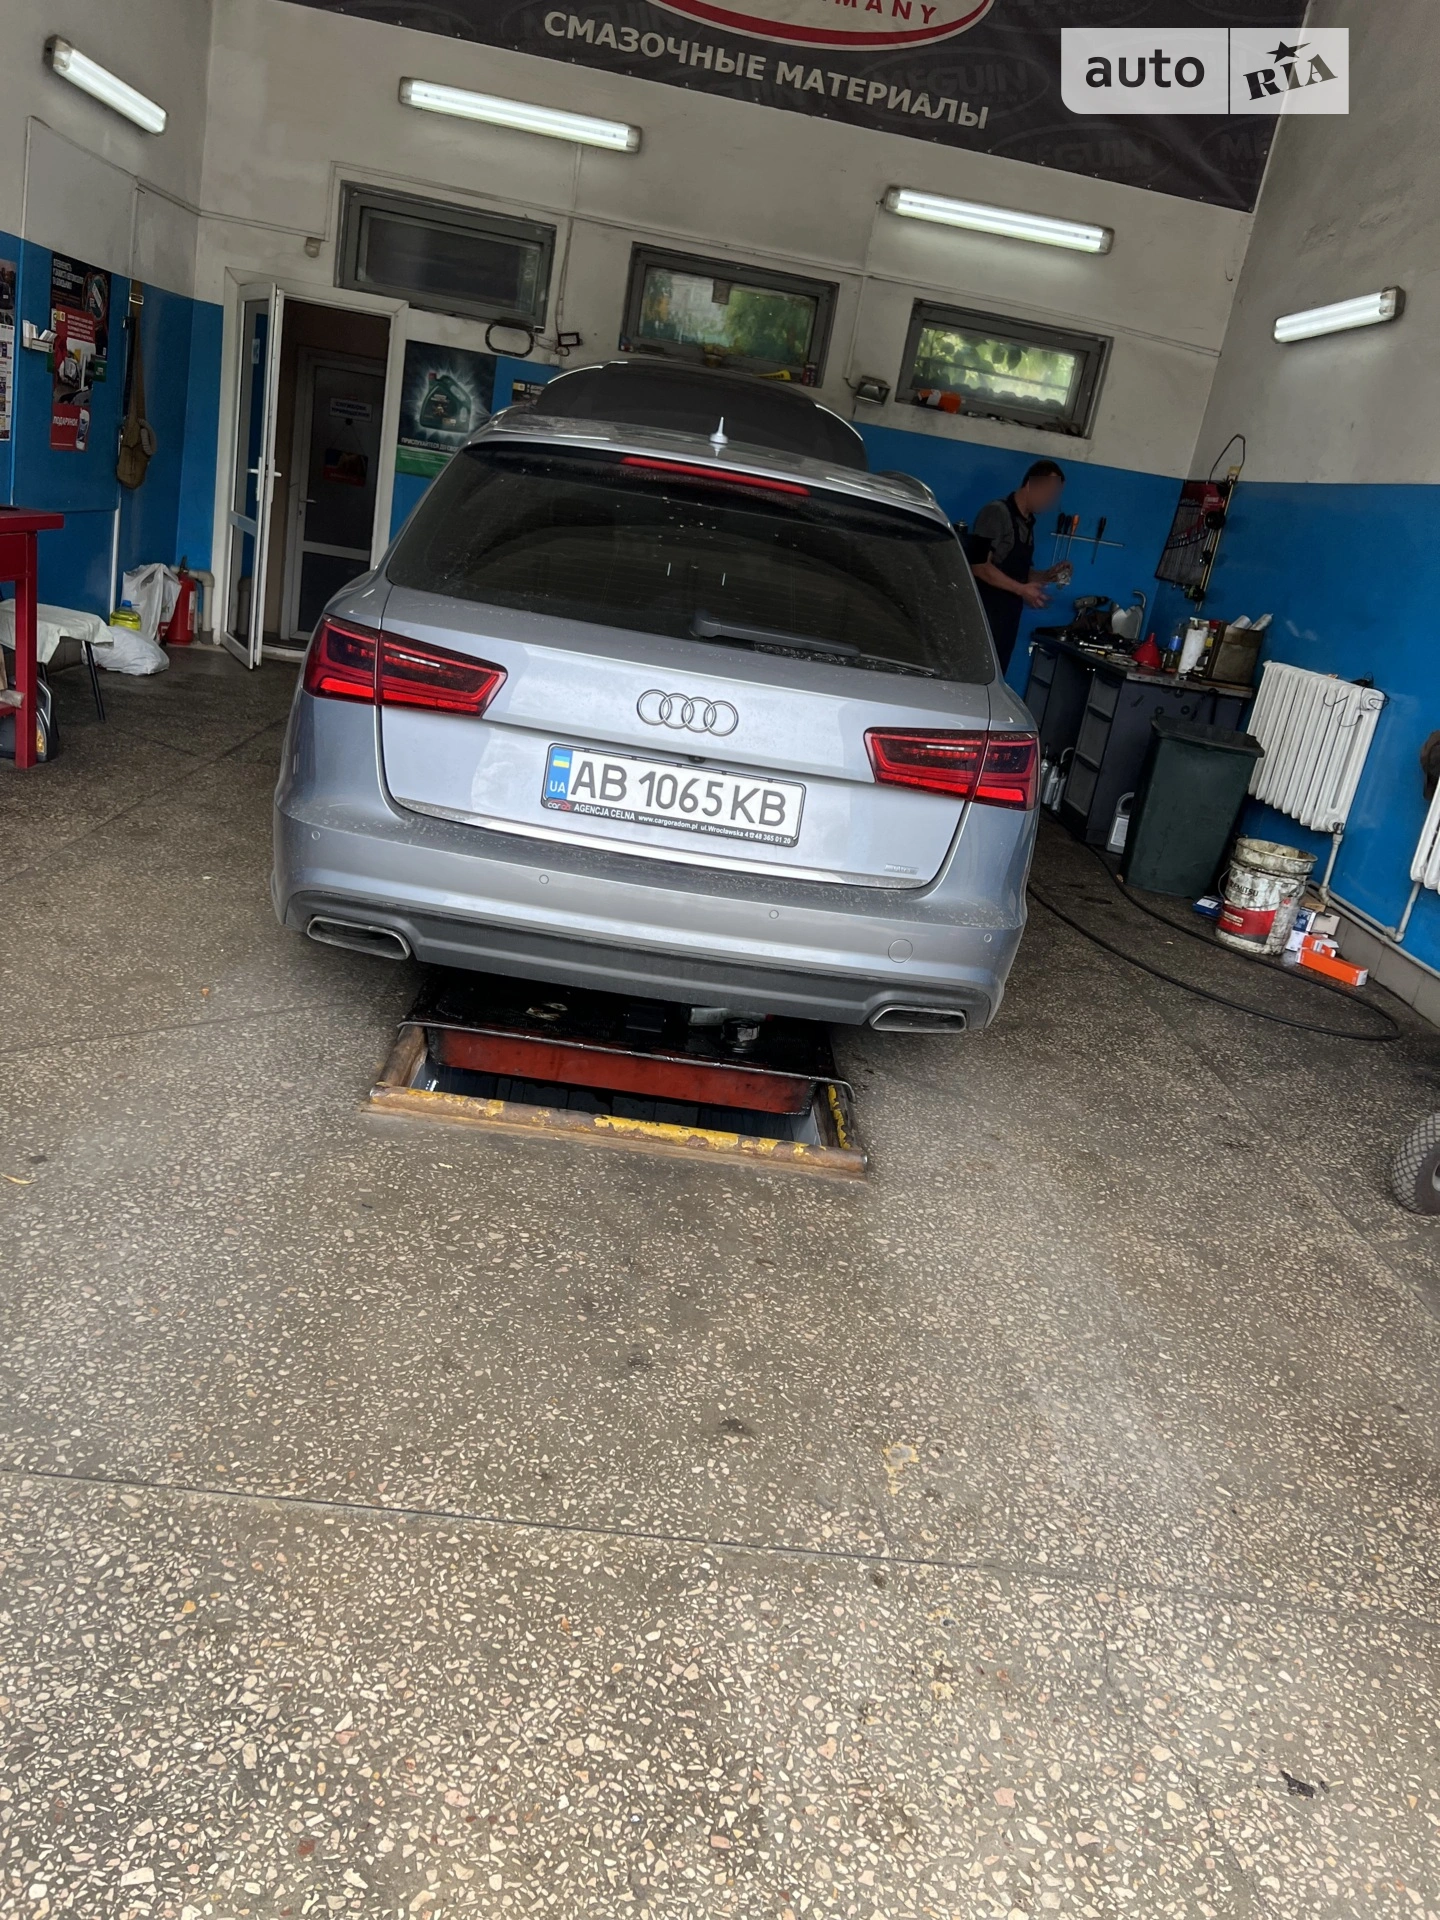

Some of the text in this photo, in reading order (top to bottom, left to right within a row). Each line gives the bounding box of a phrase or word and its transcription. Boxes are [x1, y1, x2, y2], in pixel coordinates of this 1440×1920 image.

[544, 11, 767, 81] СМАЗОЧНЫЕ
[775, 61, 989, 130] МАТЕРИАЛЫ
[549, 780, 566, 794] UA
[570, 760, 786, 827] AB 1065 KB
[573, 803, 610, 817] AGENCJA
[610, 810, 636, 821] CELNA
[638, 815, 698, 830] www.cargoradom.pl
